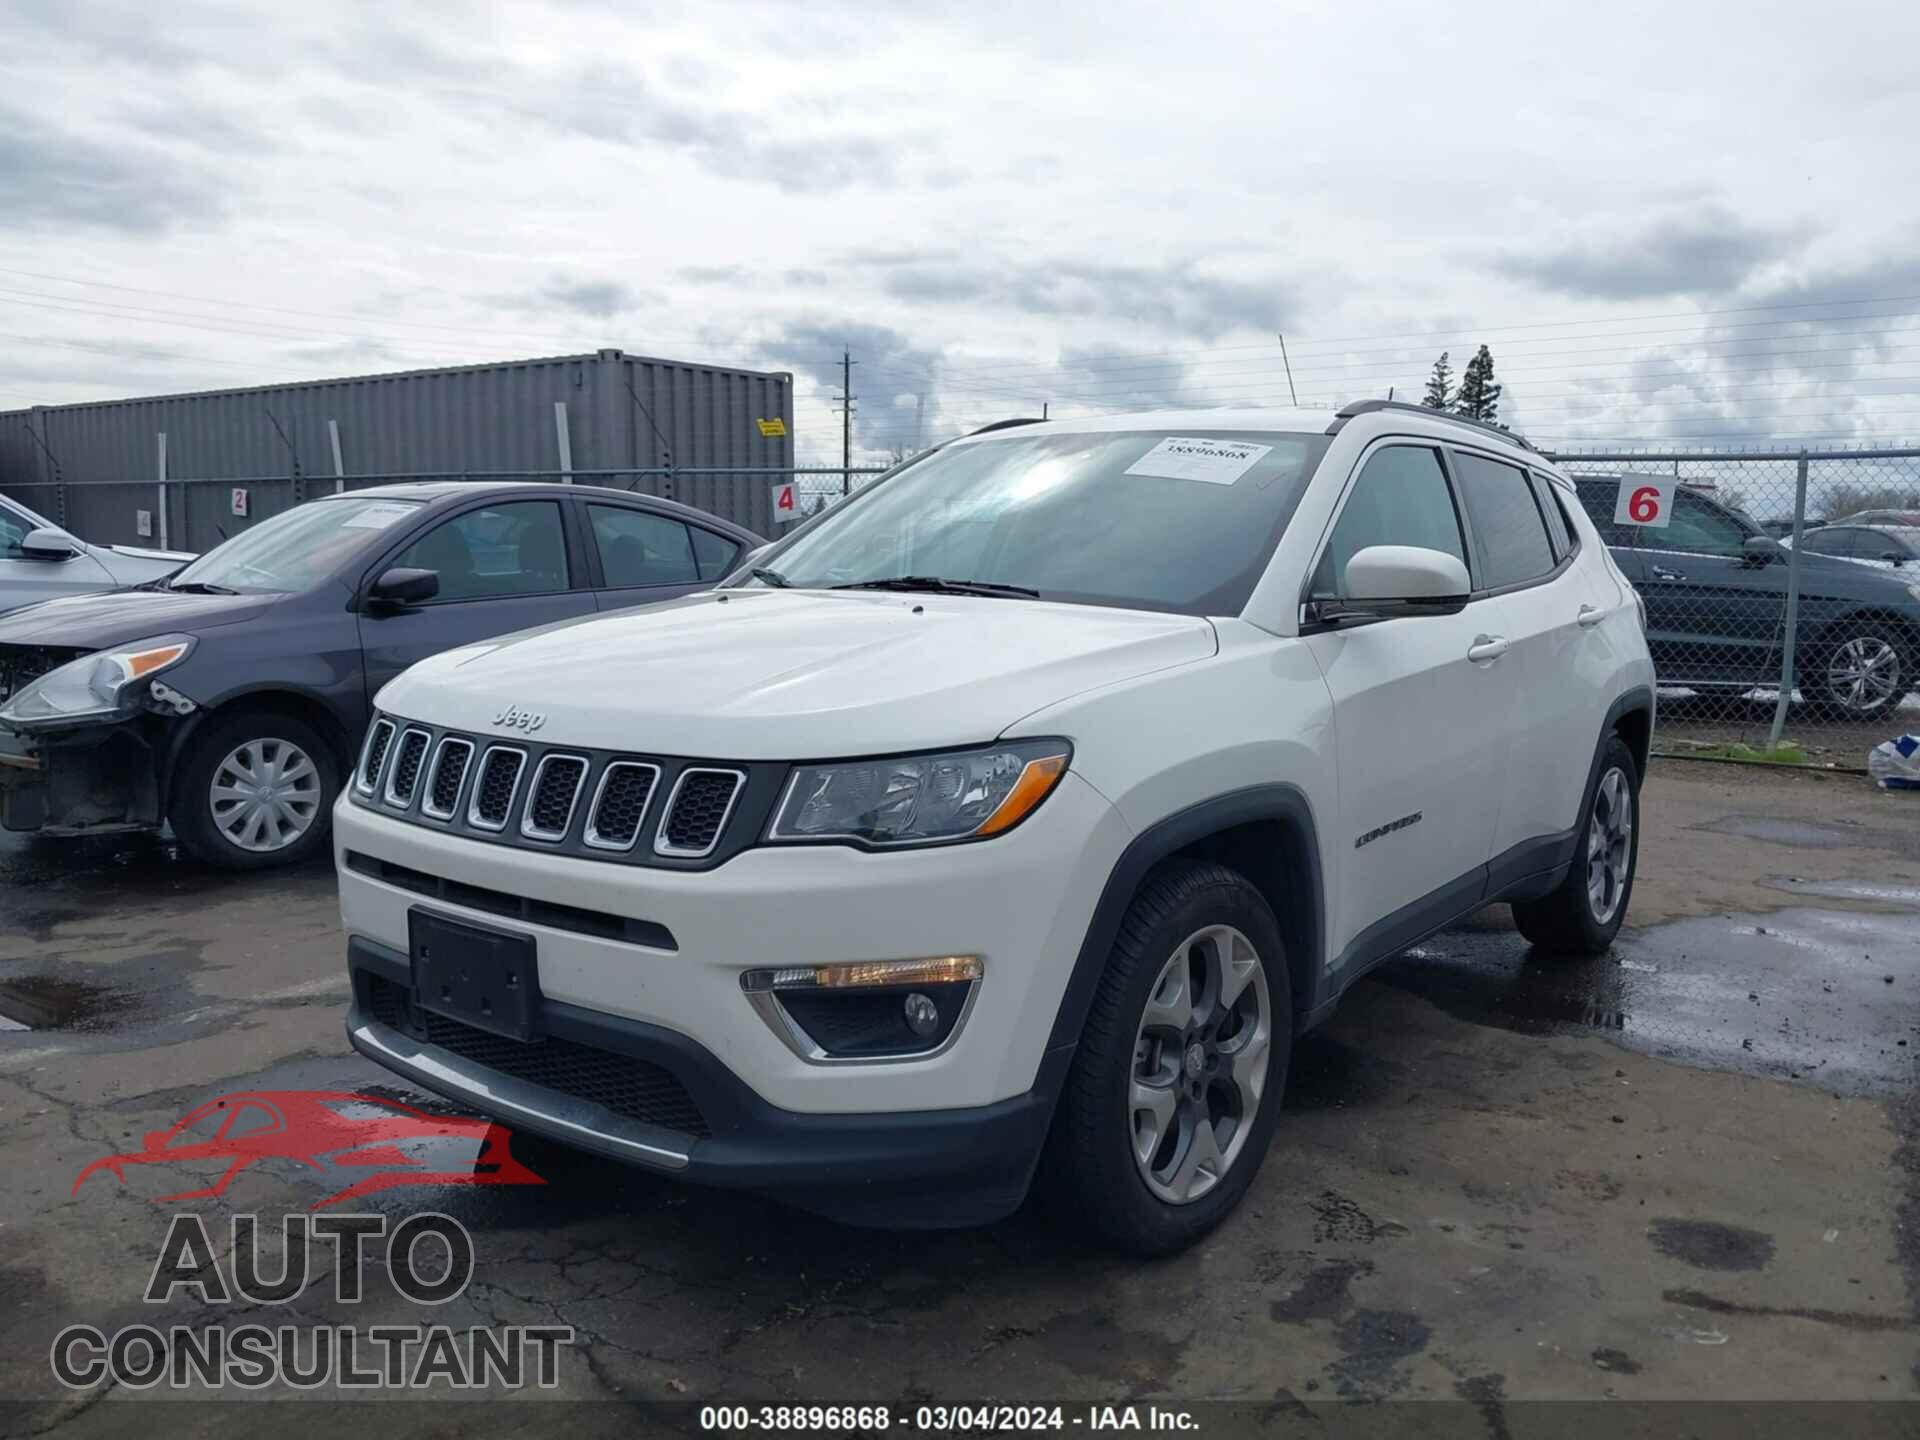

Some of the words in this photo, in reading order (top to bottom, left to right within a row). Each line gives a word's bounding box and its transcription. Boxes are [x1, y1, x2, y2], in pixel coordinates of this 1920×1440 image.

[234, 490, 243, 509] 2
[778, 486, 794, 511] 4
[1629, 486, 1660, 522] 6
[492, 704, 546, 735] Jeep
